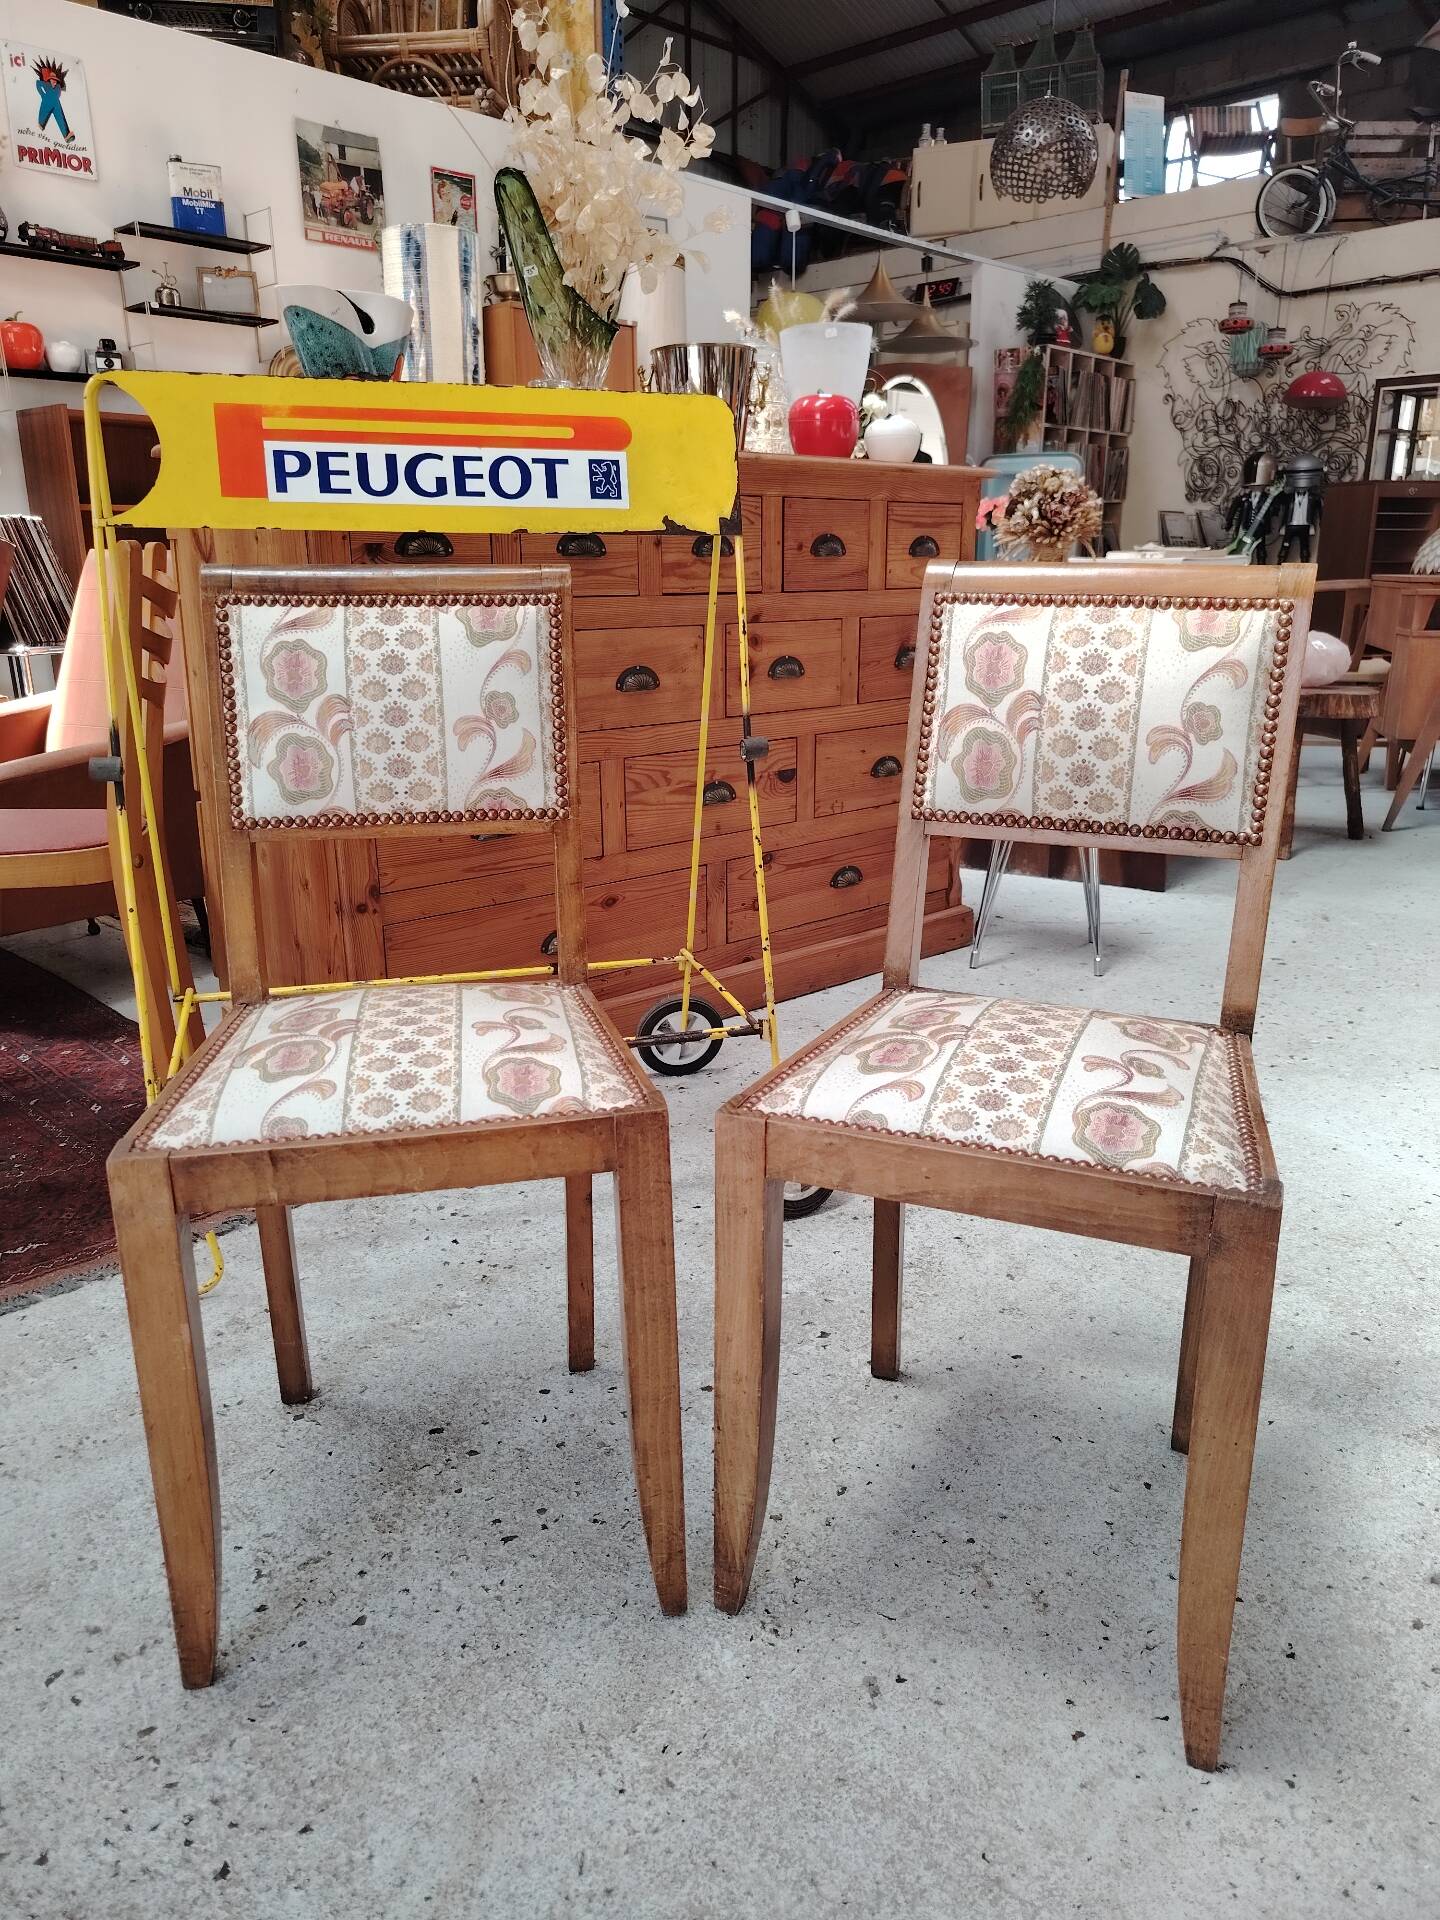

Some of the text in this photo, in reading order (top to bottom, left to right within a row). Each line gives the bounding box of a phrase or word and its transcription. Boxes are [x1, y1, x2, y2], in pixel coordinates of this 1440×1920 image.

[9, 53, 26, 67] ici
[17, 144, 94, 175] PRIMIOR
[183, 187, 213, 199] Mobil
[324, 231, 374, 247] RENAULT
[272, 449, 569, 500] PEUGEOT
